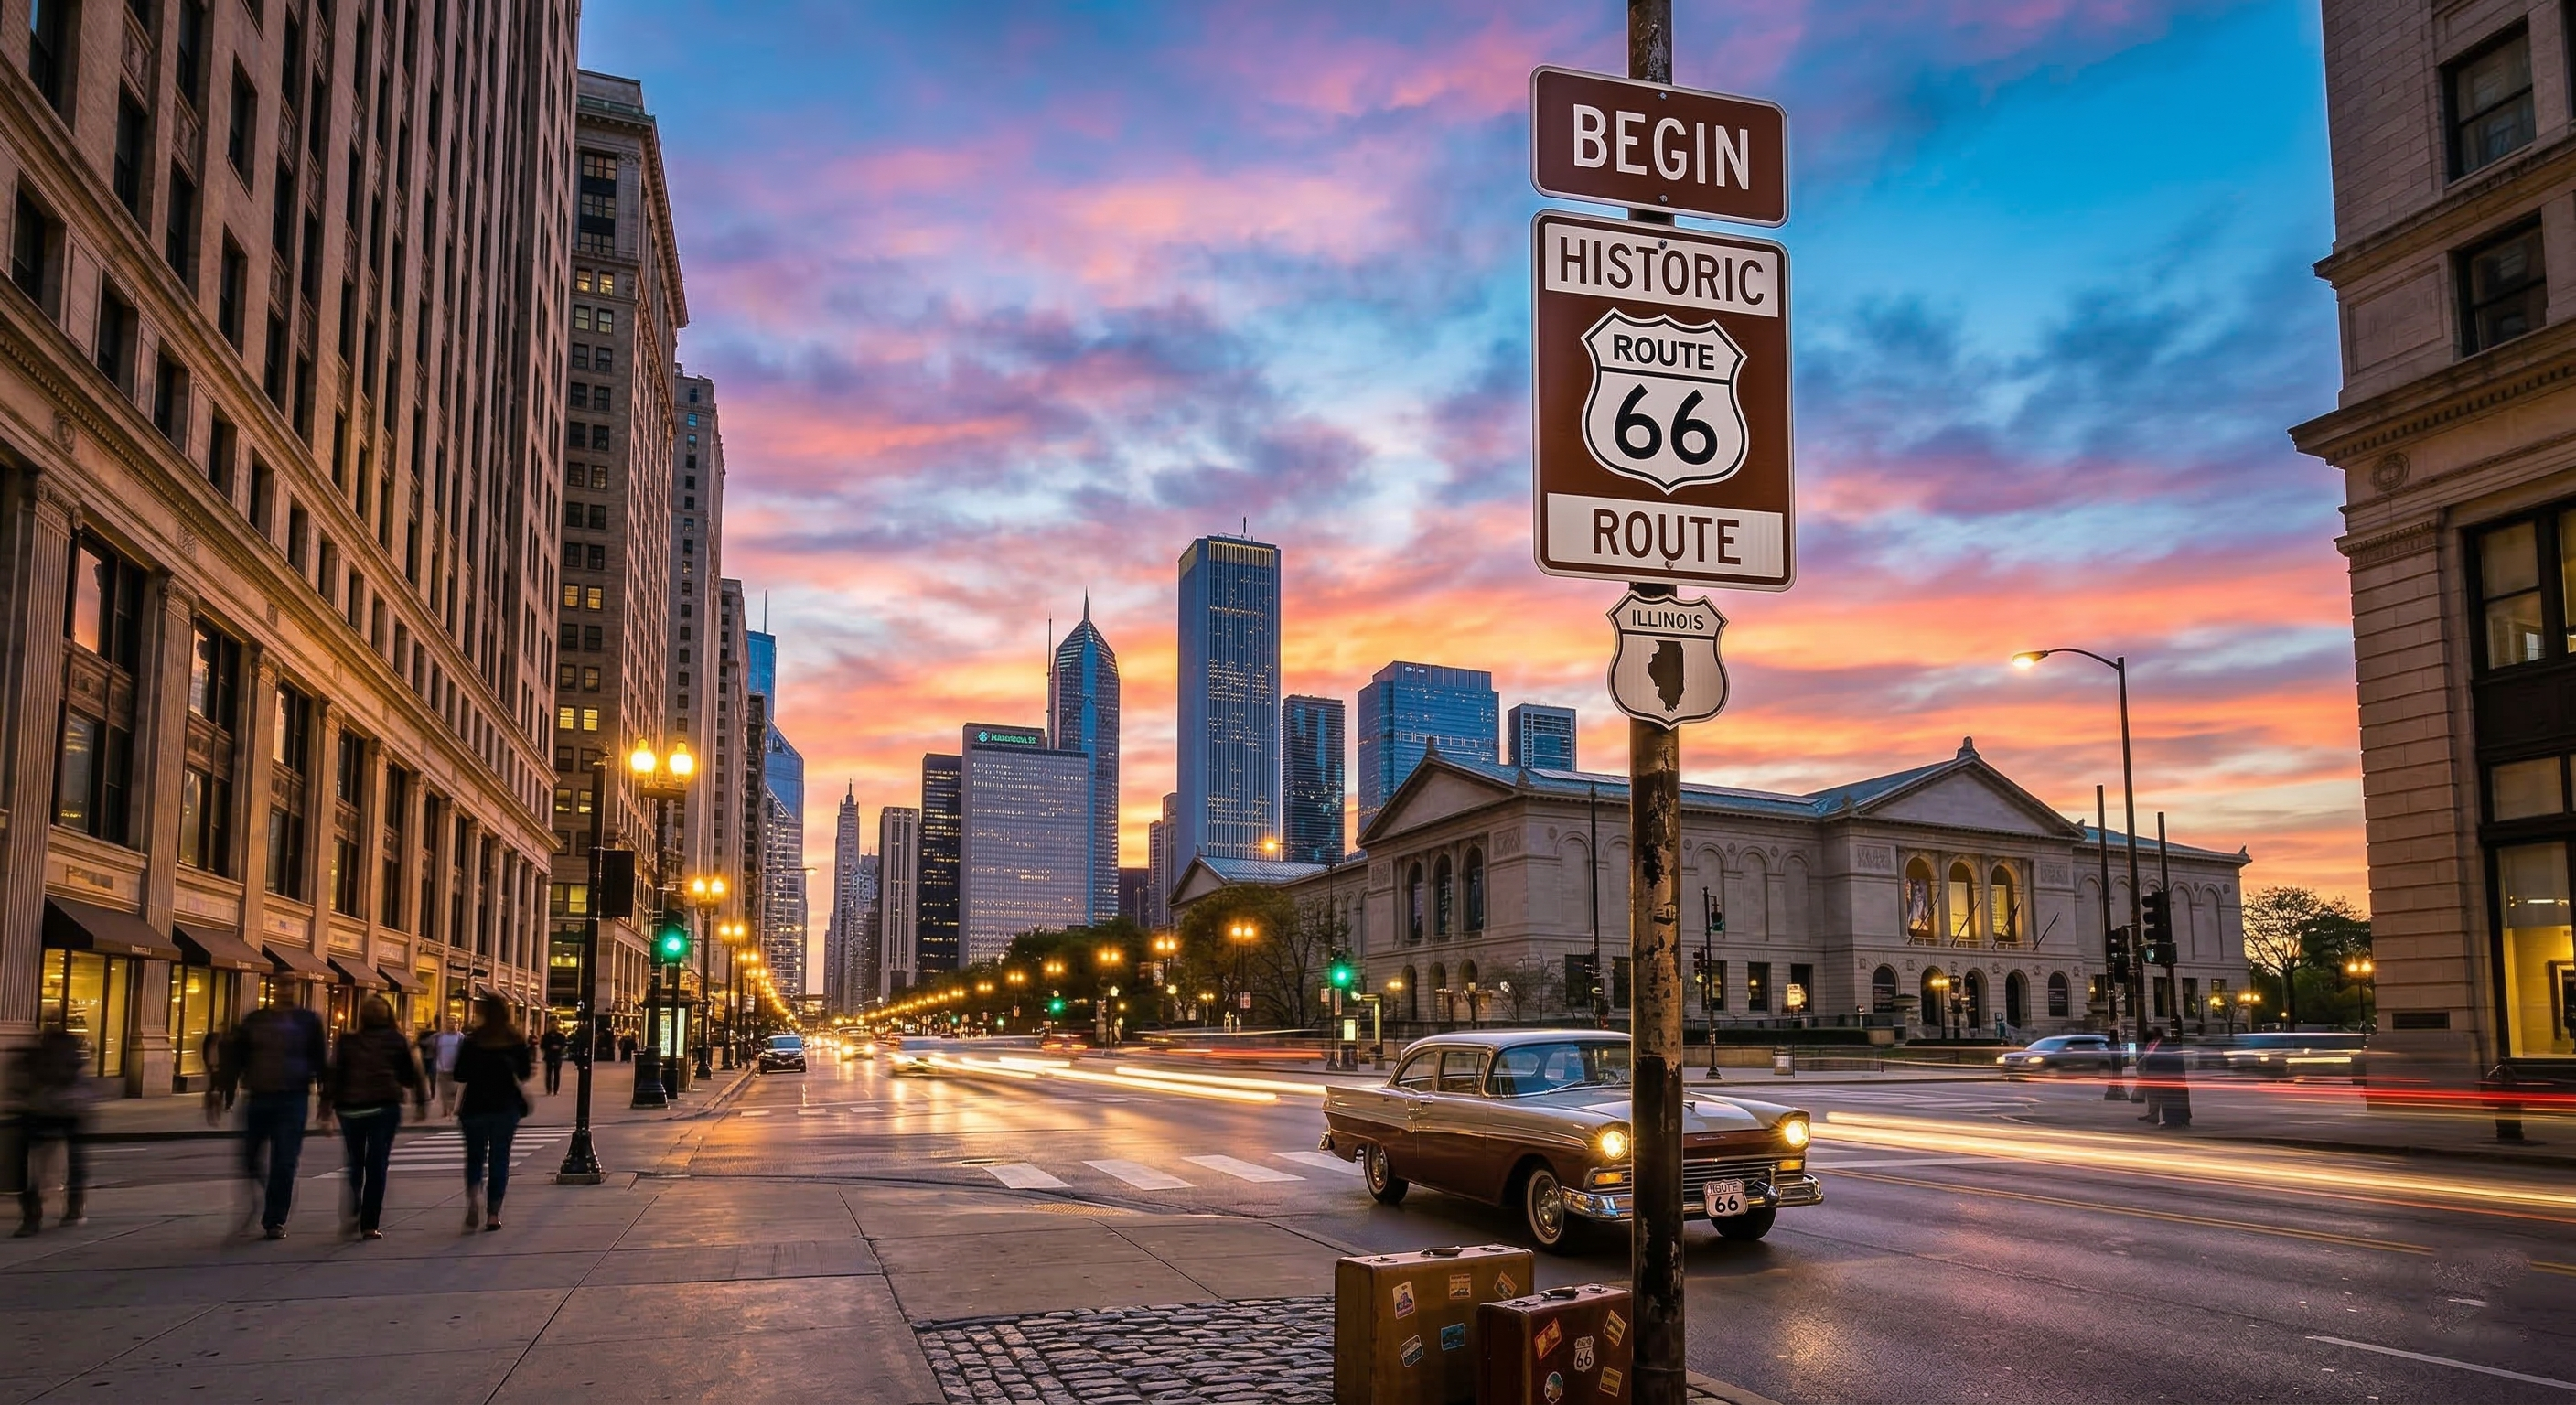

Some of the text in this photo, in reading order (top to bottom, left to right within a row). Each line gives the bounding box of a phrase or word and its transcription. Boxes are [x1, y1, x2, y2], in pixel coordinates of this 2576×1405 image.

[1572, 103, 1749, 190] BEGIN
[1560, 236, 1765, 306] HISTORIC
[1613, 333, 1715, 370] ROUTE
[1614, 382, 1718, 465] 66
[1593, 508, 1741, 565] ROUTE
[1632, 609, 1704, 630] ILLINOIS
[1715, 1195, 1738, 1213] 66
[1577, 1350, 1592, 1367] 66
